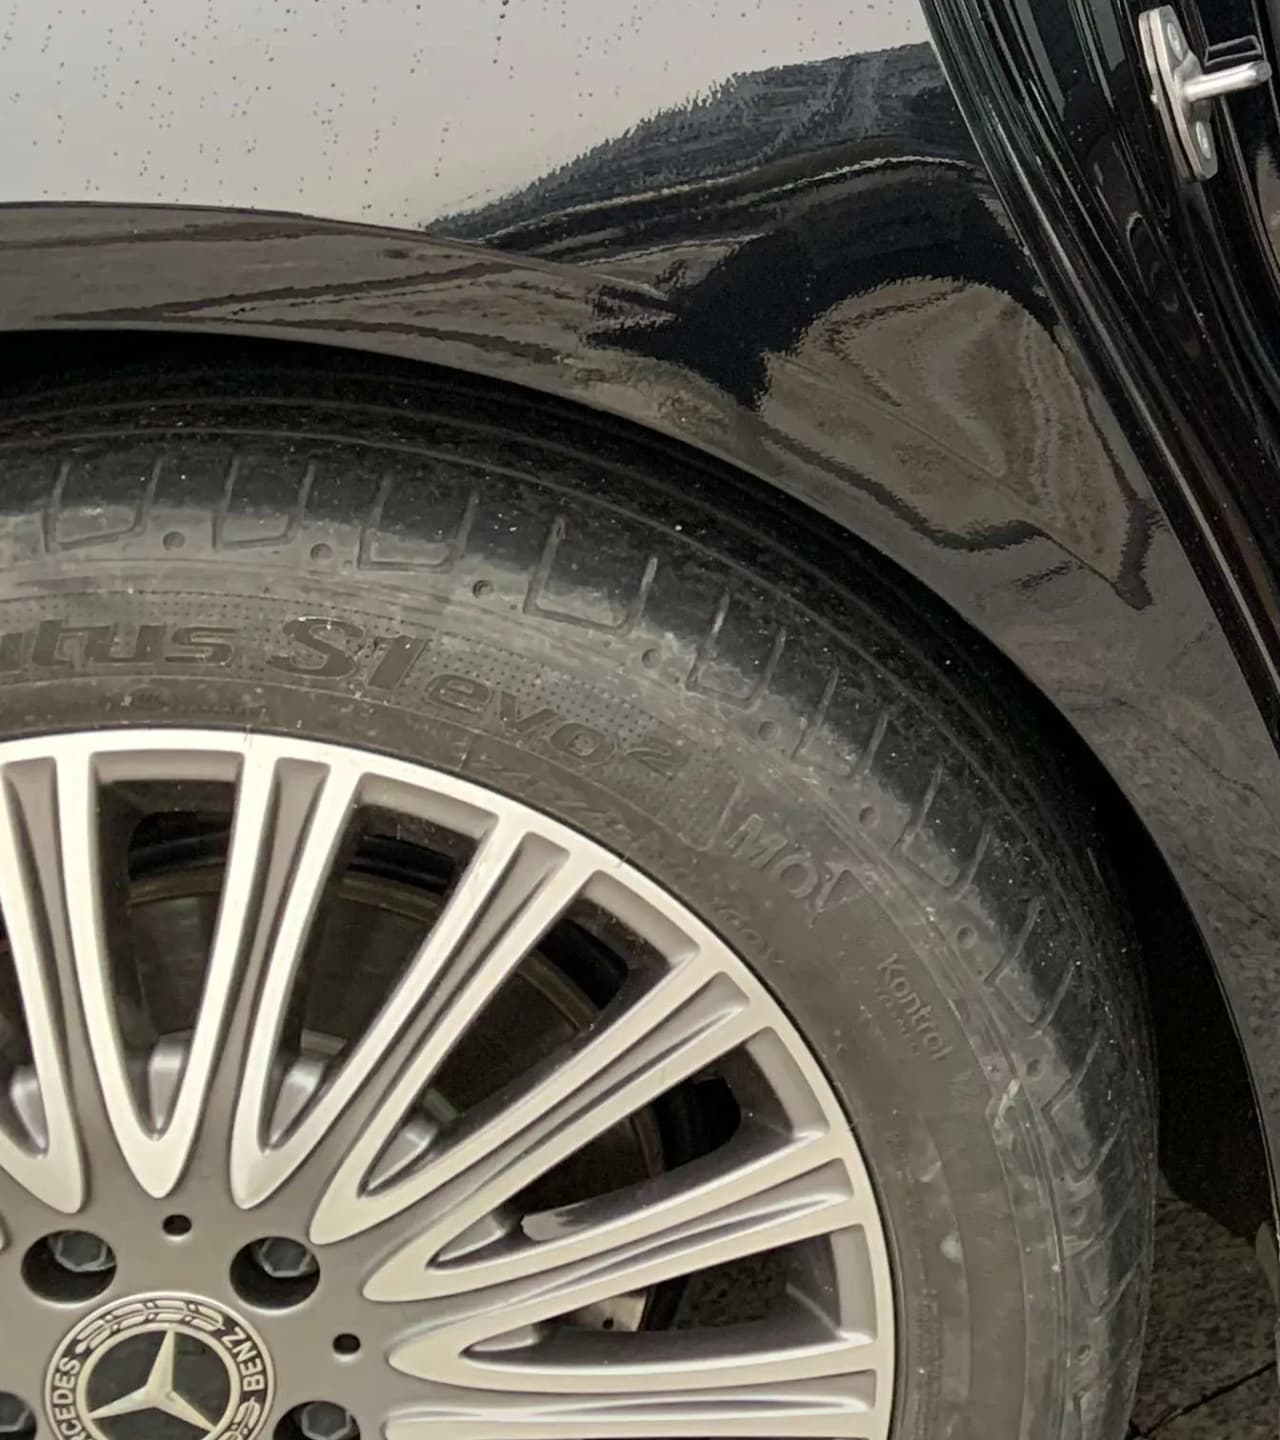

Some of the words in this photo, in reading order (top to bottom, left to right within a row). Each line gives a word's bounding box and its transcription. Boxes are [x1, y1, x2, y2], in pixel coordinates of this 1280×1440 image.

[268, 615, 434, 691] S1
[876, 952, 953, 1060] Kontrol
[221, 1326, 265, 1391] BENZ
